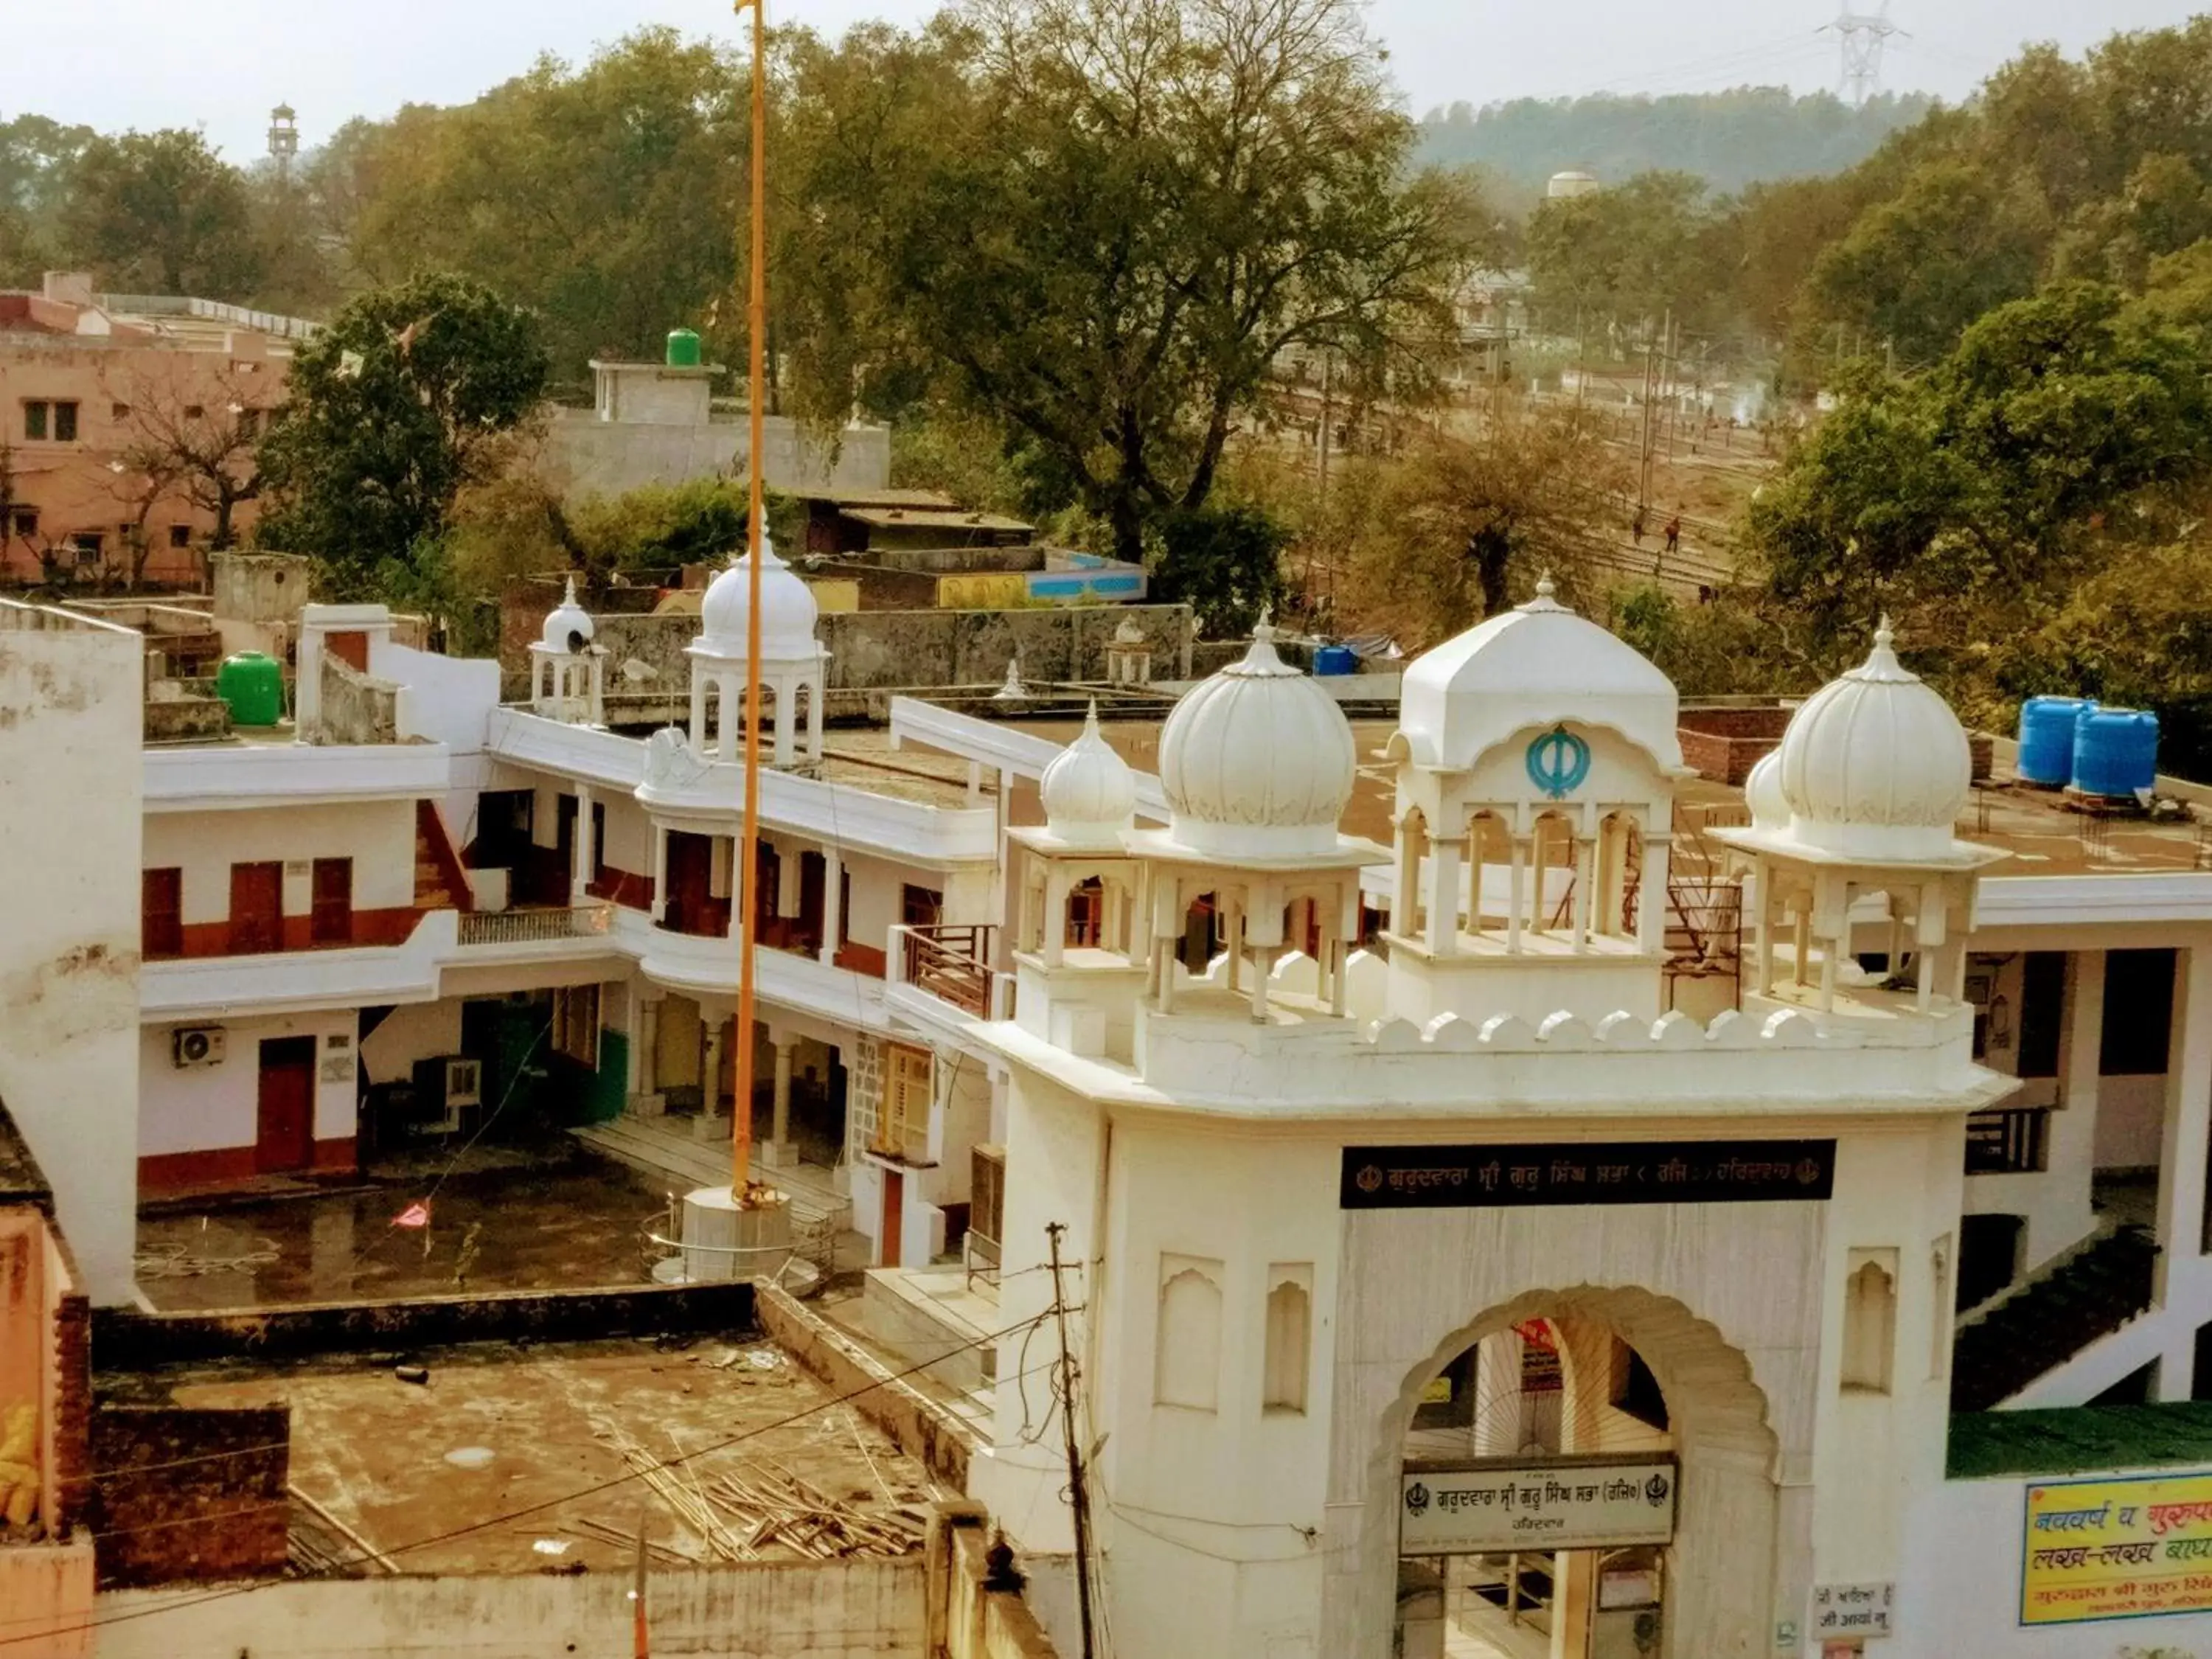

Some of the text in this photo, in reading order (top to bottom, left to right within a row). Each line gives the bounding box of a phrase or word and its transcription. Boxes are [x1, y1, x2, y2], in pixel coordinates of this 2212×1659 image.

[1545, 1481, 1571, 1504] ਸਿੰਘ
[1576, 1486, 1599, 1502] ਸਭਾ
[2034, 1499, 2212, 1536] नववर्ष व गुरुप
